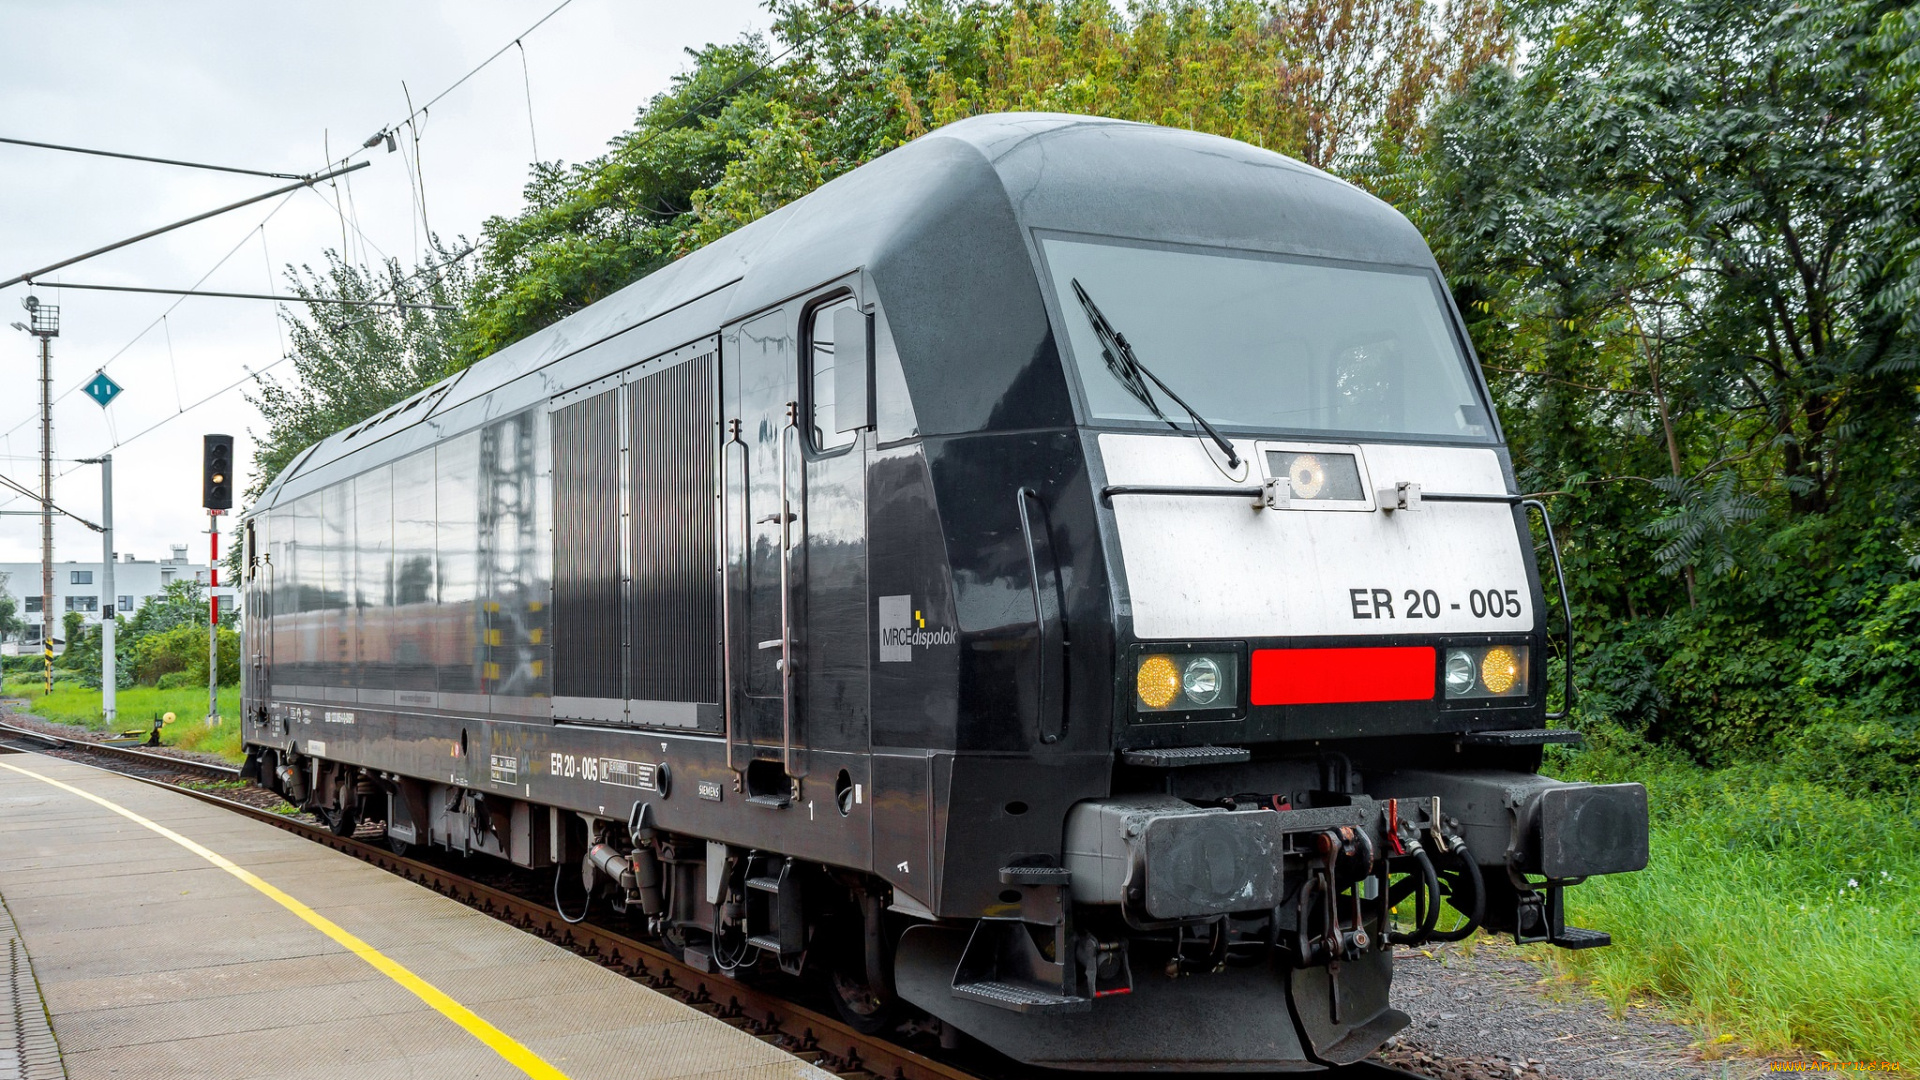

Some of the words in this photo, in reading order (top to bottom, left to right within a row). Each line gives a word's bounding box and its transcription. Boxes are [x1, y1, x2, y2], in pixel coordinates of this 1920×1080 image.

[1349, 588, 1396, 619] ER
[1403, 589, 1441, 619] 20
[1469, 588, 1522, 618] 005
[550, 752, 563, 776] ER
[564, 754, 575, 778] 20
[582, 756, 598, 782] 005
[698, 784, 719, 798] SIEMENS
[808, 800, 814, 821] 1
